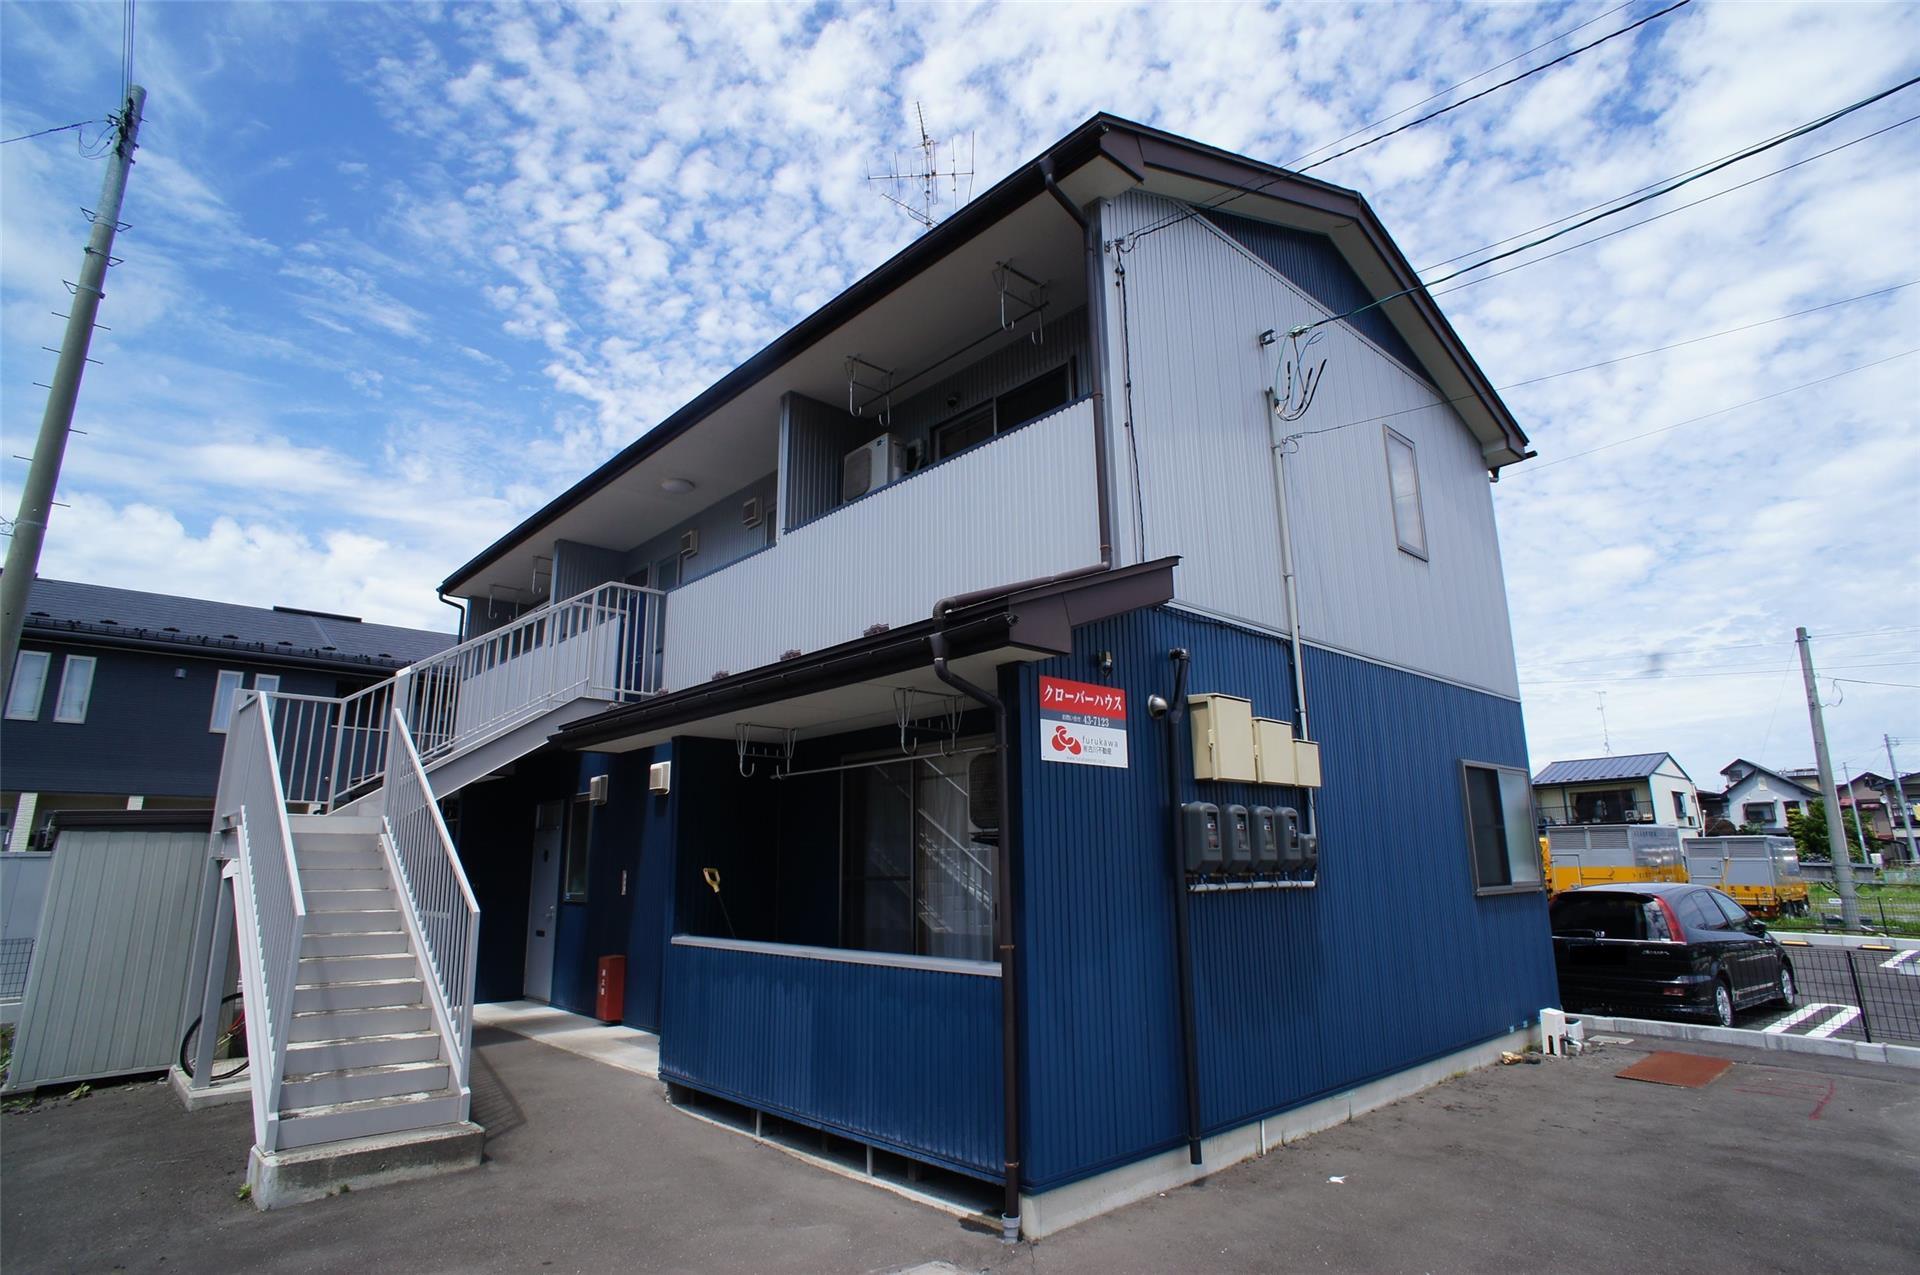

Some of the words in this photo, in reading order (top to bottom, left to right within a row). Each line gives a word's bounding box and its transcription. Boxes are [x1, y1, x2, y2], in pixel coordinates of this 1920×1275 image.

[1044, 684, 1121, 711] クローバーハウス
[1083, 715, 1109, 727] 43-7123
[1082, 736, 1118, 748] furukawa
